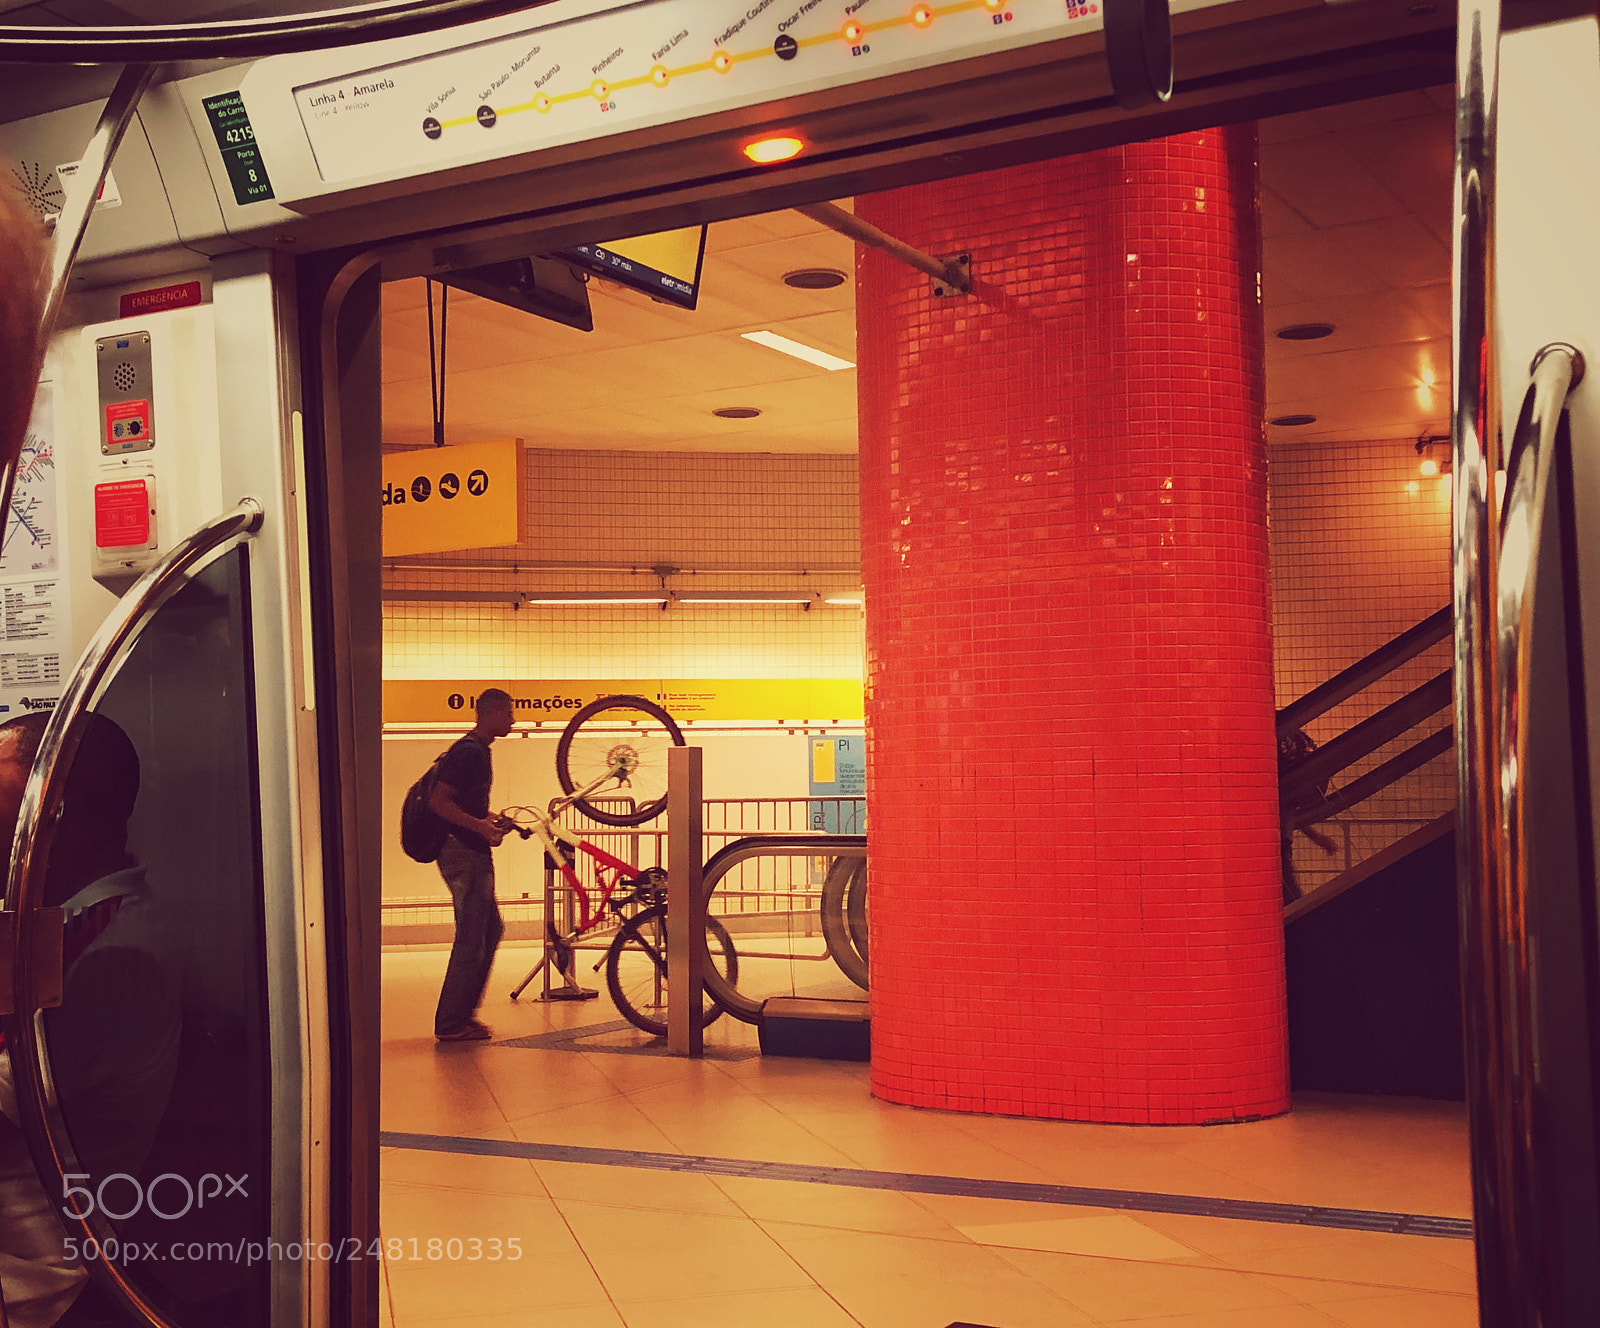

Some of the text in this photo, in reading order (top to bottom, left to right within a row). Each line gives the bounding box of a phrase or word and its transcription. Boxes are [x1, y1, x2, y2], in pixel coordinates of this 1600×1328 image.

[778, 12, 800, 32] Oscar
[713, 18, 747, 47] Fradique
[651, 29, 689, 61] Faria Lima
[490, 72, 510, 91] Paulo
[511, 45, 541, 73] Morumbi
[592, 46, 624, 75] Pinheiros
[309, 78, 395, 107] Linha 4 Amarela
[227, 106, 245, 116] Carro
[226, 125, 254, 143] 4215
[237, 150, 255, 159] Porta
[248, 168, 258, 182] 8
[247, 184, 268, 195] Via 01
